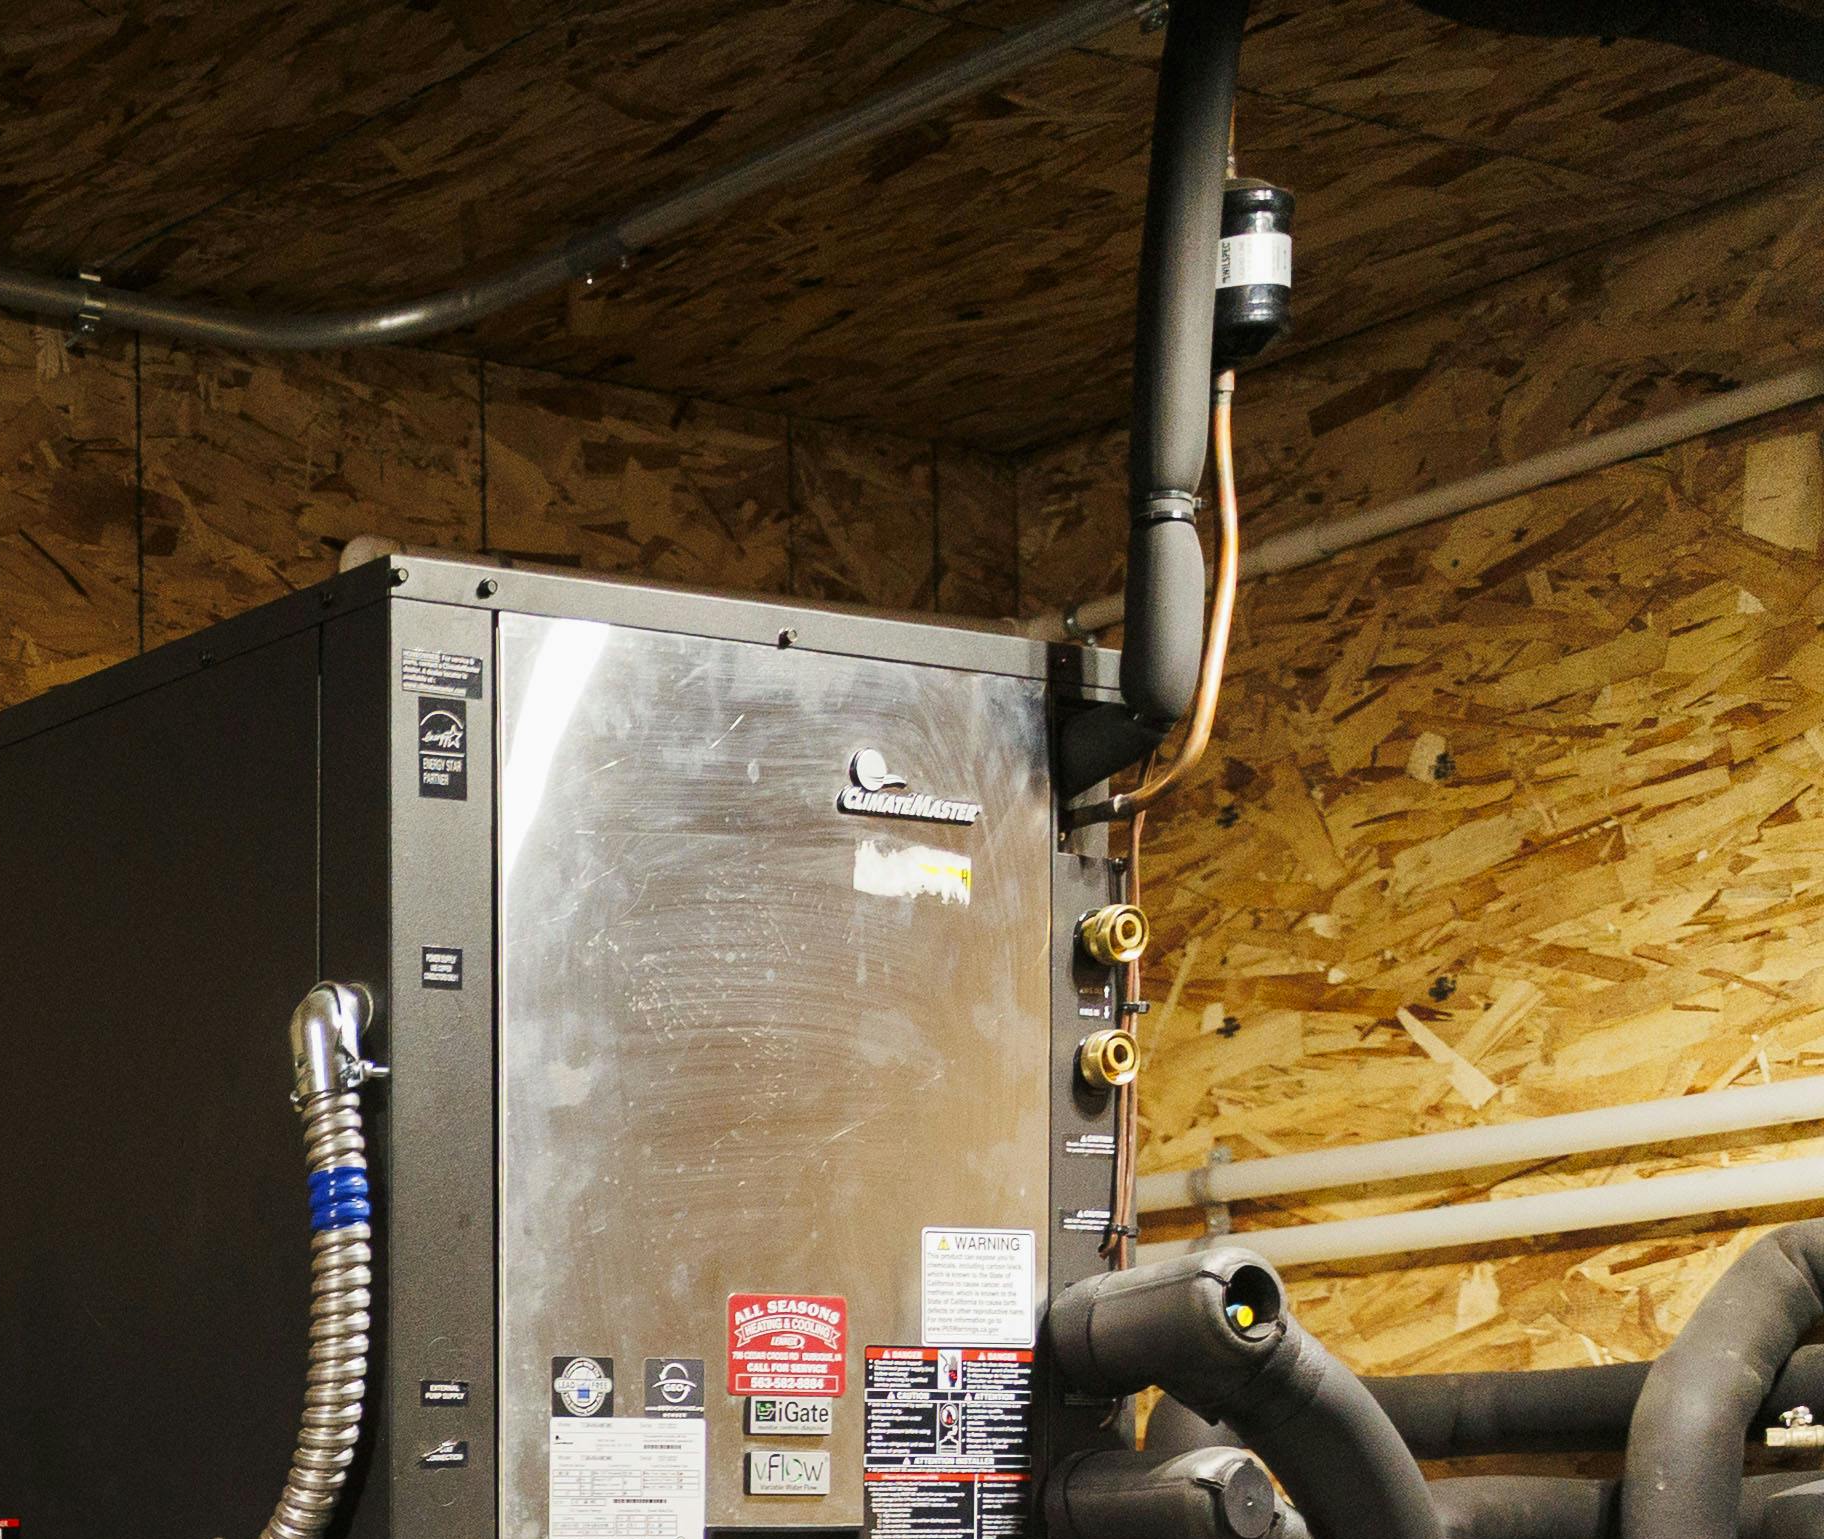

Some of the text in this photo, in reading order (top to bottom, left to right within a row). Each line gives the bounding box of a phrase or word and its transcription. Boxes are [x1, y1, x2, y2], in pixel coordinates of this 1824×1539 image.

[423, 757, 462, 772] ENERGY STAR
[955, 1236, 1020, 1251] WARNING
[735, 1300, 840, 1325] ALL SEASONS
[745, 1318, 830, 1337] HEATING & COOLING
[747, 1363, 828, 1373] CALL FOR SERVICE
[663, 1384, 683, 1392] GEO
[779, 1402, 829, 1422] iGate
